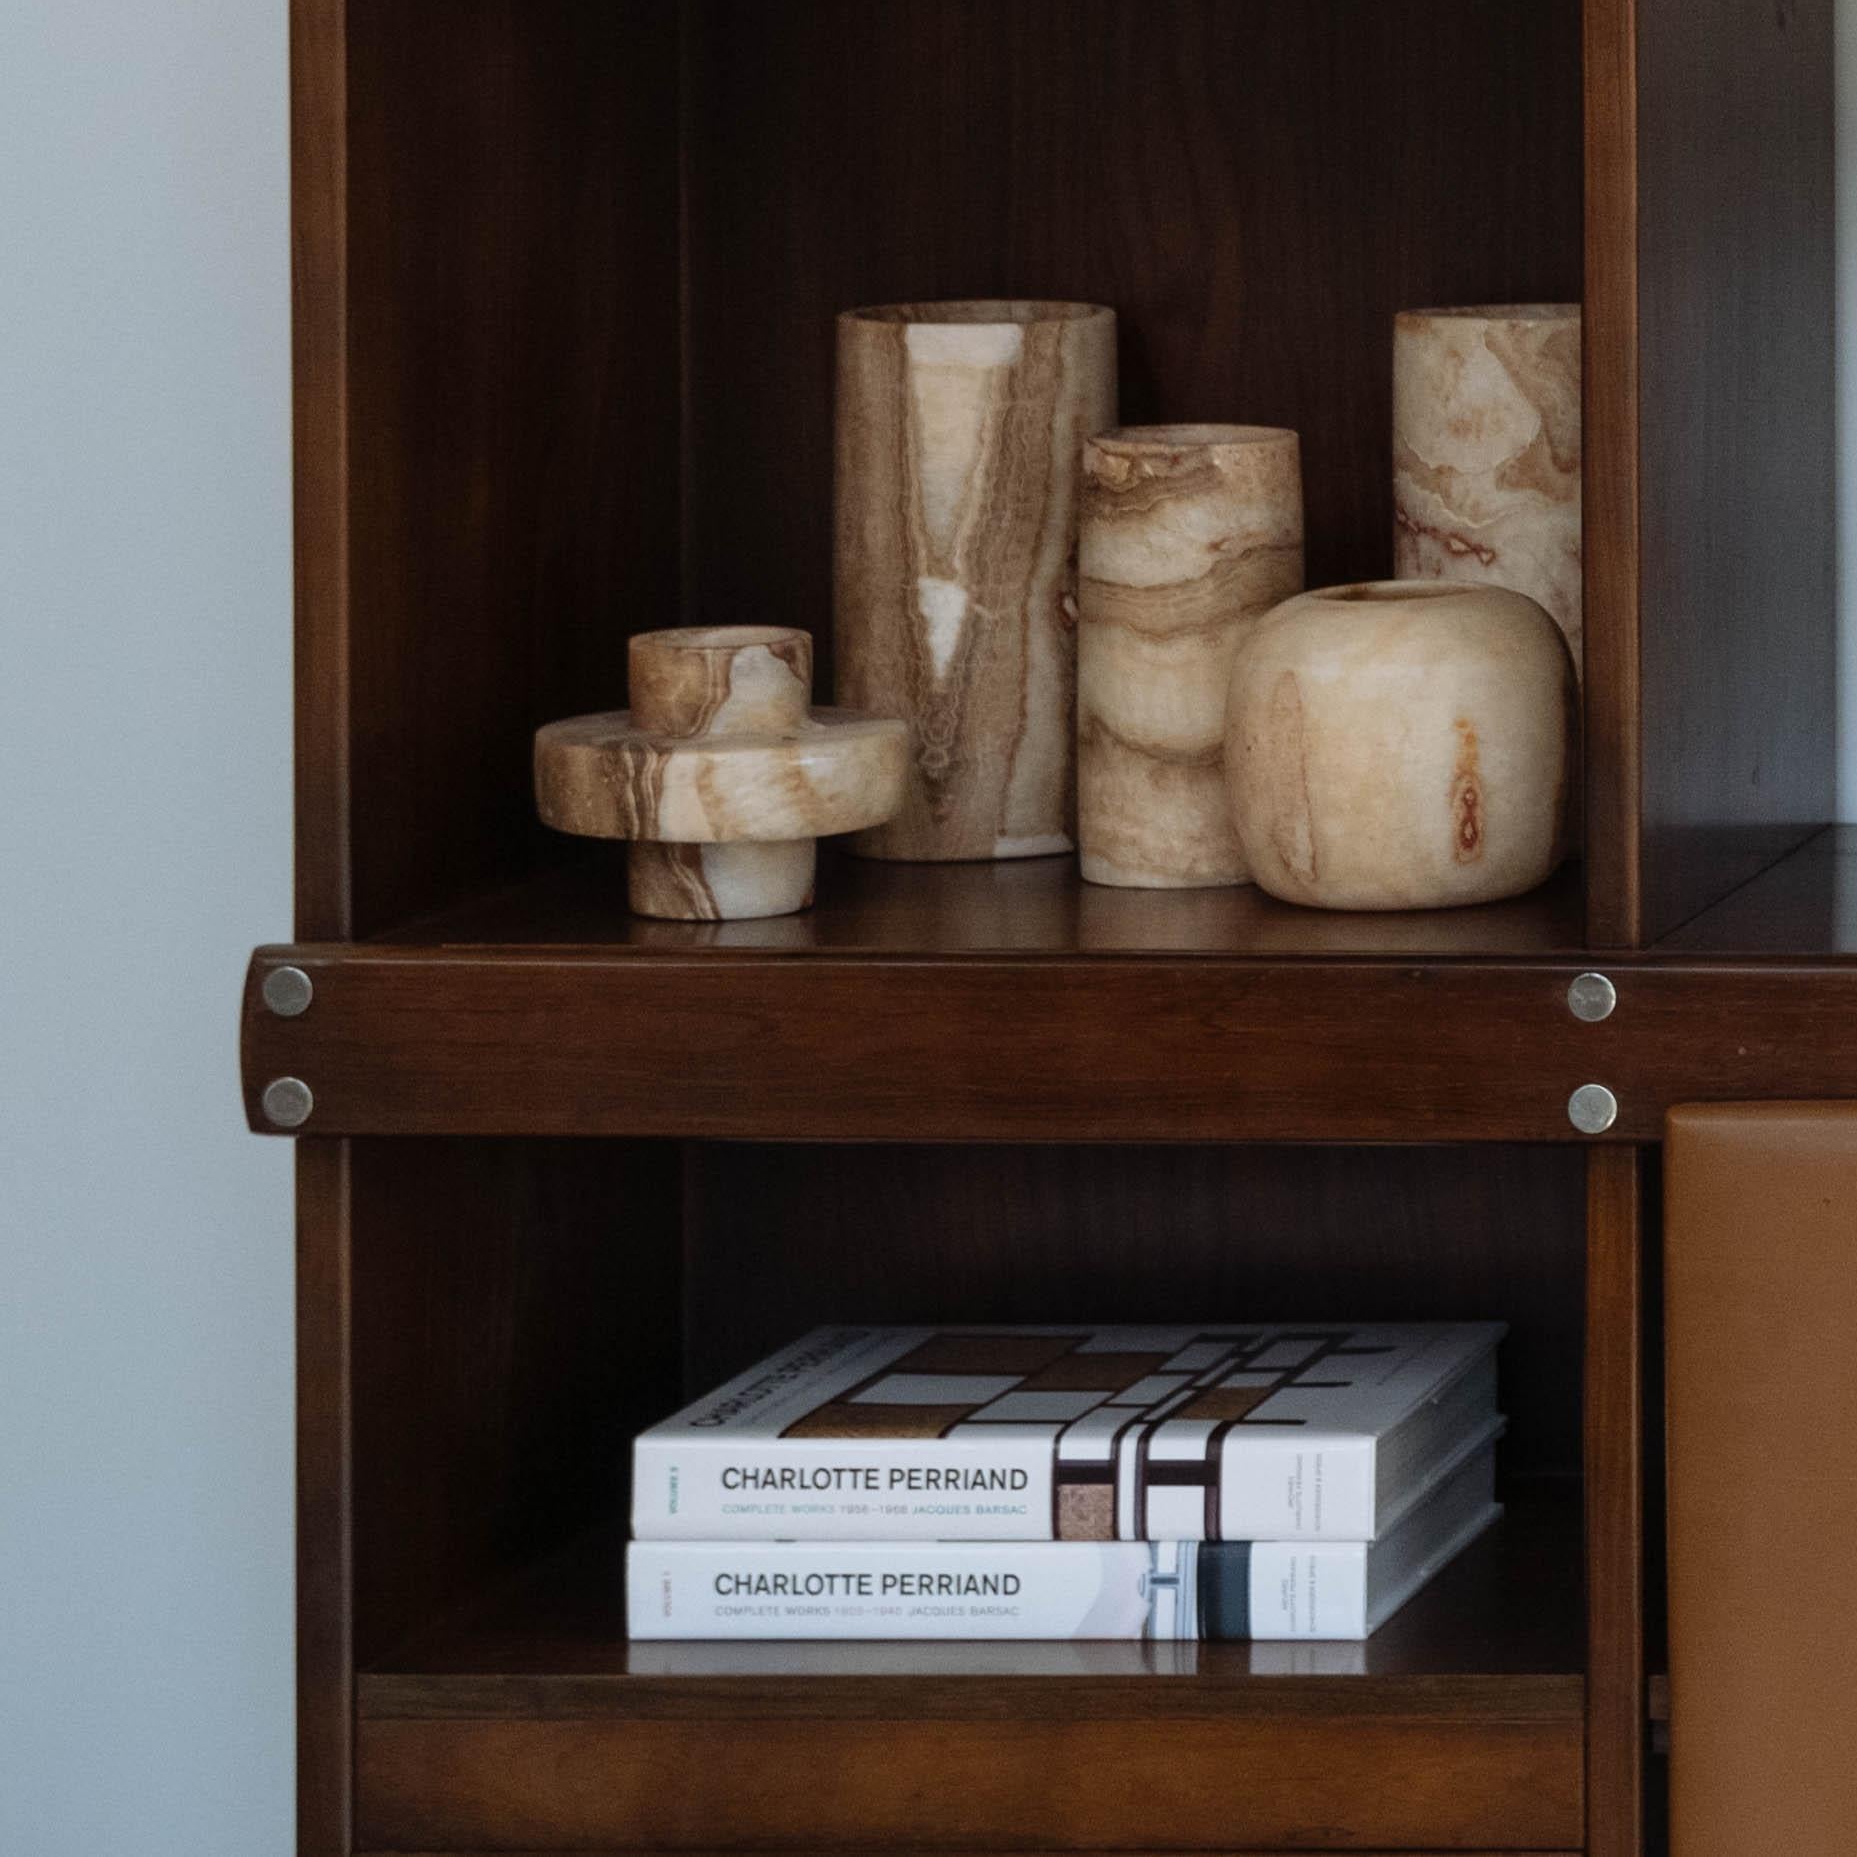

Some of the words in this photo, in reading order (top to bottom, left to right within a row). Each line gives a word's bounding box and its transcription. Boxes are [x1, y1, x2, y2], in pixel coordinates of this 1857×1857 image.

[722, 1467, 880, 1490] CHARLOTTE
[889, 1467, 1028, 1490] PERRIAND
[722, 1504, 785, 1515] COMPLETE
[791, 1504, 836, 1515] WORKS
[912, 1504, 971, 1515] JACQUES
[976, 1504, 1027, 1515] BARSAC
[715, 1573, 873, 1596] CHARLOTTE
[882, 1573, 1021, 1596] PERRIAND
[715, 1606, 780, 1617] COMPLETE
[785, 1606, 831, 1617] WORKS
[909, 1606, 965, 1617] JACQUES
[970, 1606, 1020, 1617] BARSAC
